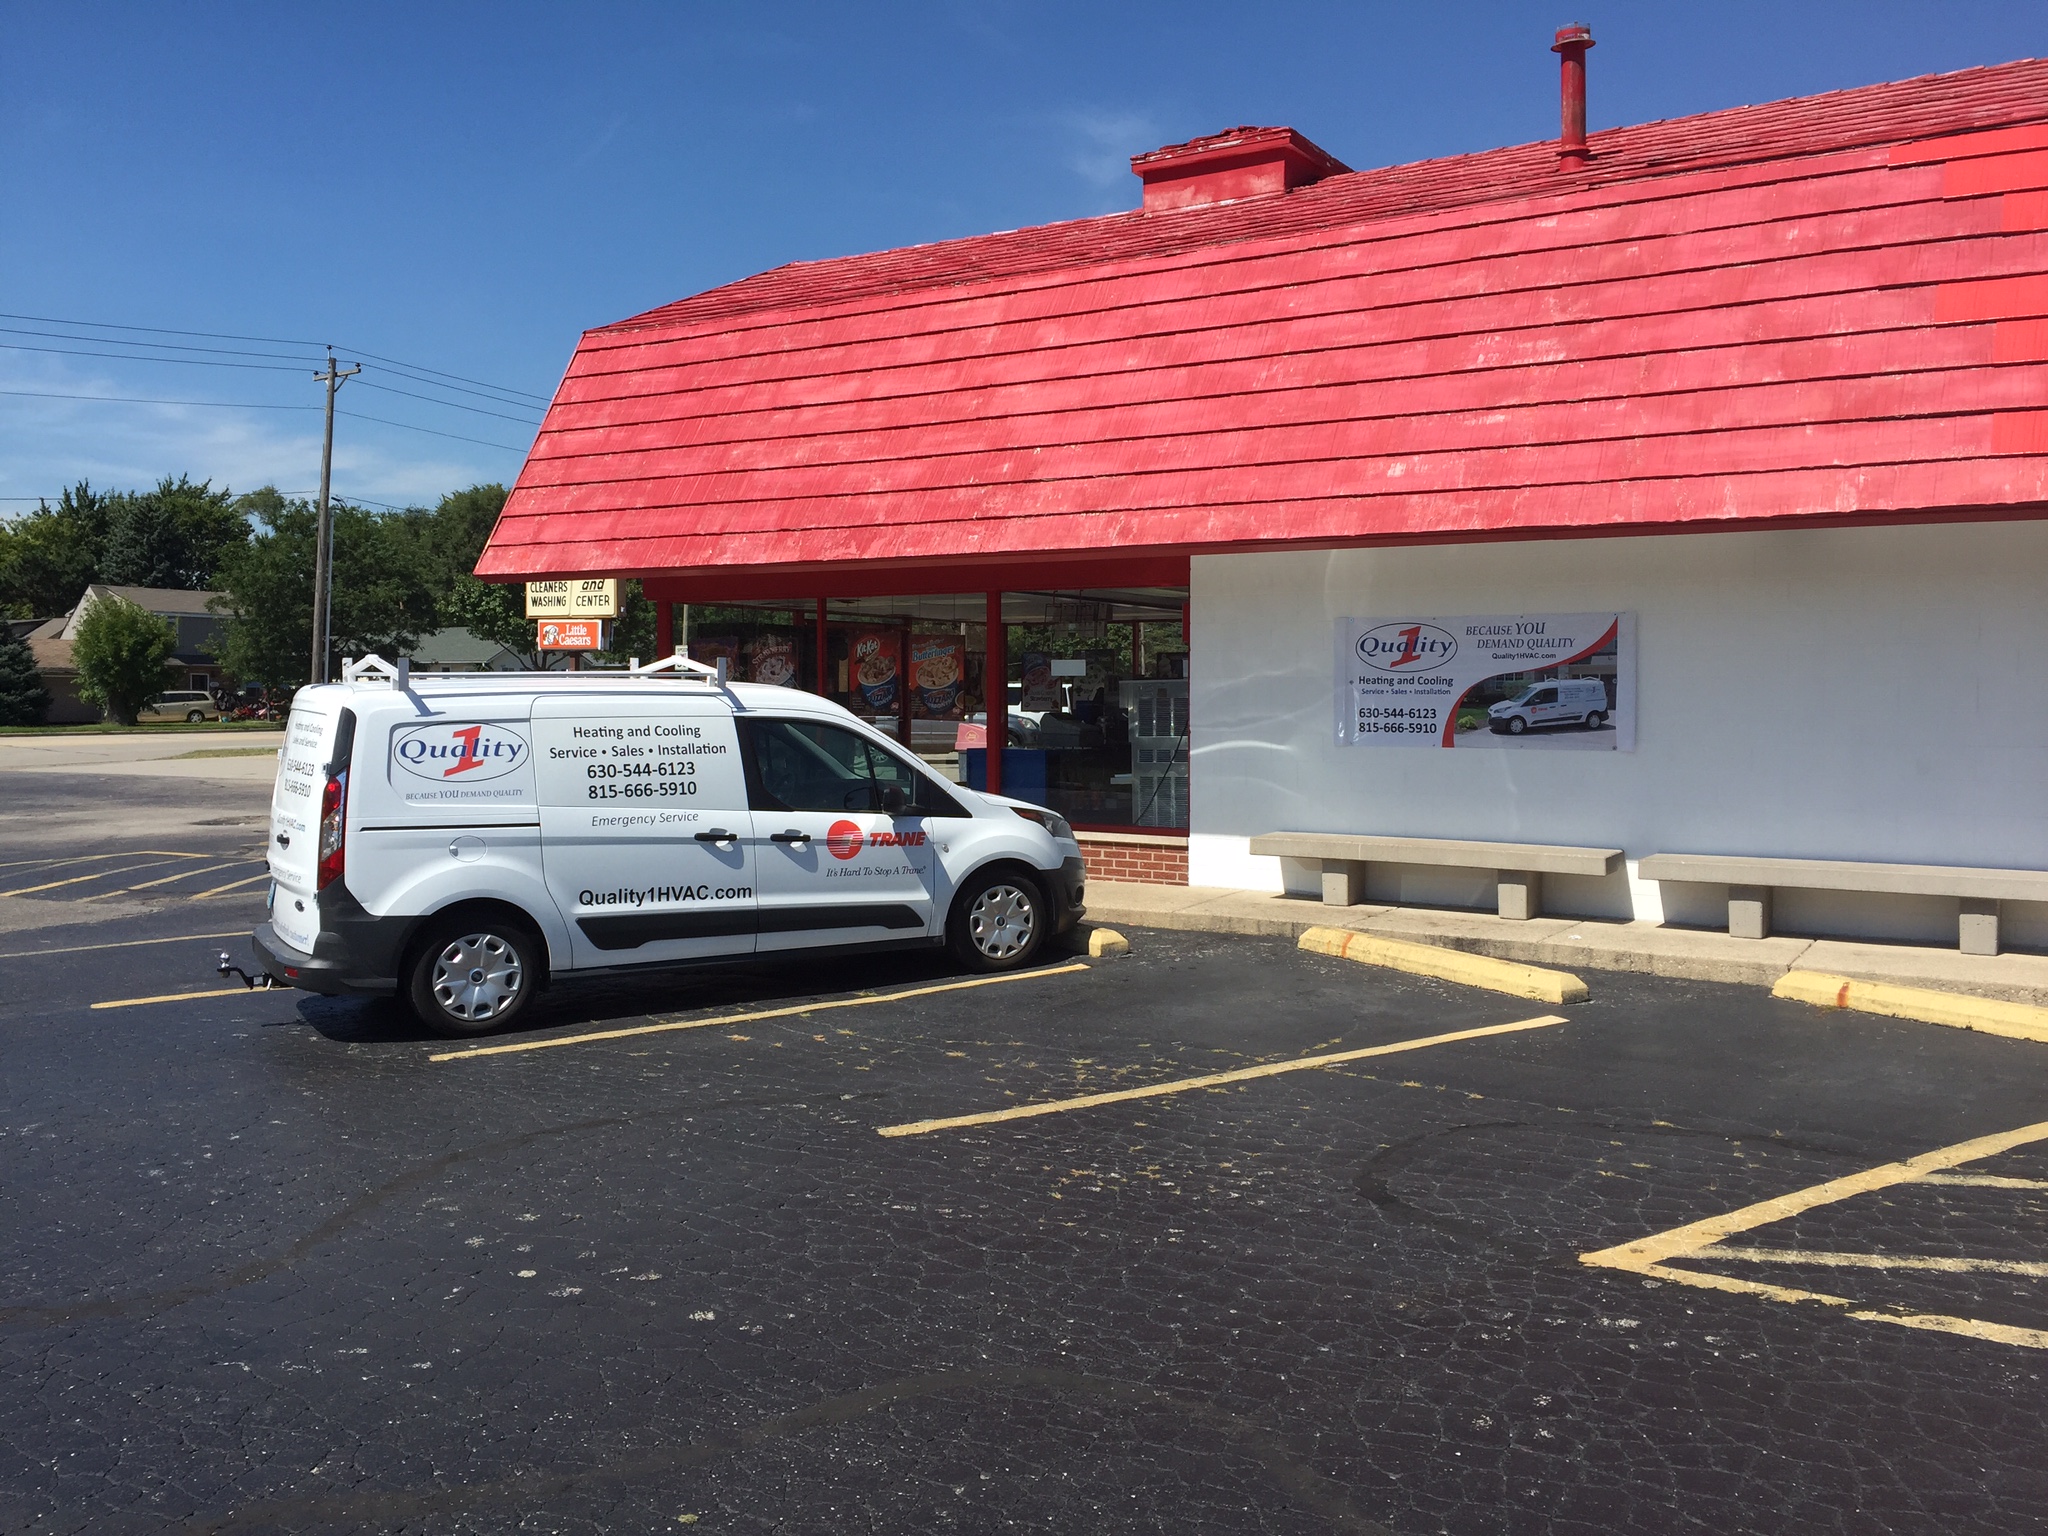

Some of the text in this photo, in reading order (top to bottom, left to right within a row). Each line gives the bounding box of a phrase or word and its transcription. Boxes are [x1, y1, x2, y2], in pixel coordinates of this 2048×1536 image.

[530, 579, 605, 593] CLEANERS and
[531, 595, 610, 607] WASHING CENTER
[565, 624, 587, 635] Little
[1466, 622, 1546, 636] BECAUSE YOU
[558, 634, 591, 646] Caesars
[1360, 636, 1453, 657] Quality
[1477, 638, 1576, 650] DEMAND QUALITY
[912, 645, 955, 662] Butterfinger
[1491, 652, 1557, 660] Quality1HVAC.com
[1358, 676, 1454, 687] Heating and Cooling
[1358, 708, 1437, 719] 630-544-6123
[573, 725, 701, 740] Heating and Cooling
[1358, 722, 1437, 733] 815-666-5910
[400, 737, 523, 764] Quality
[549, 743, 727, 759] Service Sales Installation
[587, 761, 696, 779] 630-544-6123
[405, 789, 523, 800] BECAUSE YOU DEMAND QUALITY
[588, 781, 697, 799] 815-666-5910
[591, 812, 699, 827] Emergency Service
[869, 832, 926, 847] TRANE
[826, 867, 838, 877] It's
[840, 867, 862, 877] Hard
[863, 867, 873, 876] To
[874, 866, 893, 877] Stop
[893, 867, 900, 875] A
[579, 884, 752, 907] Quality1HVAC.com
